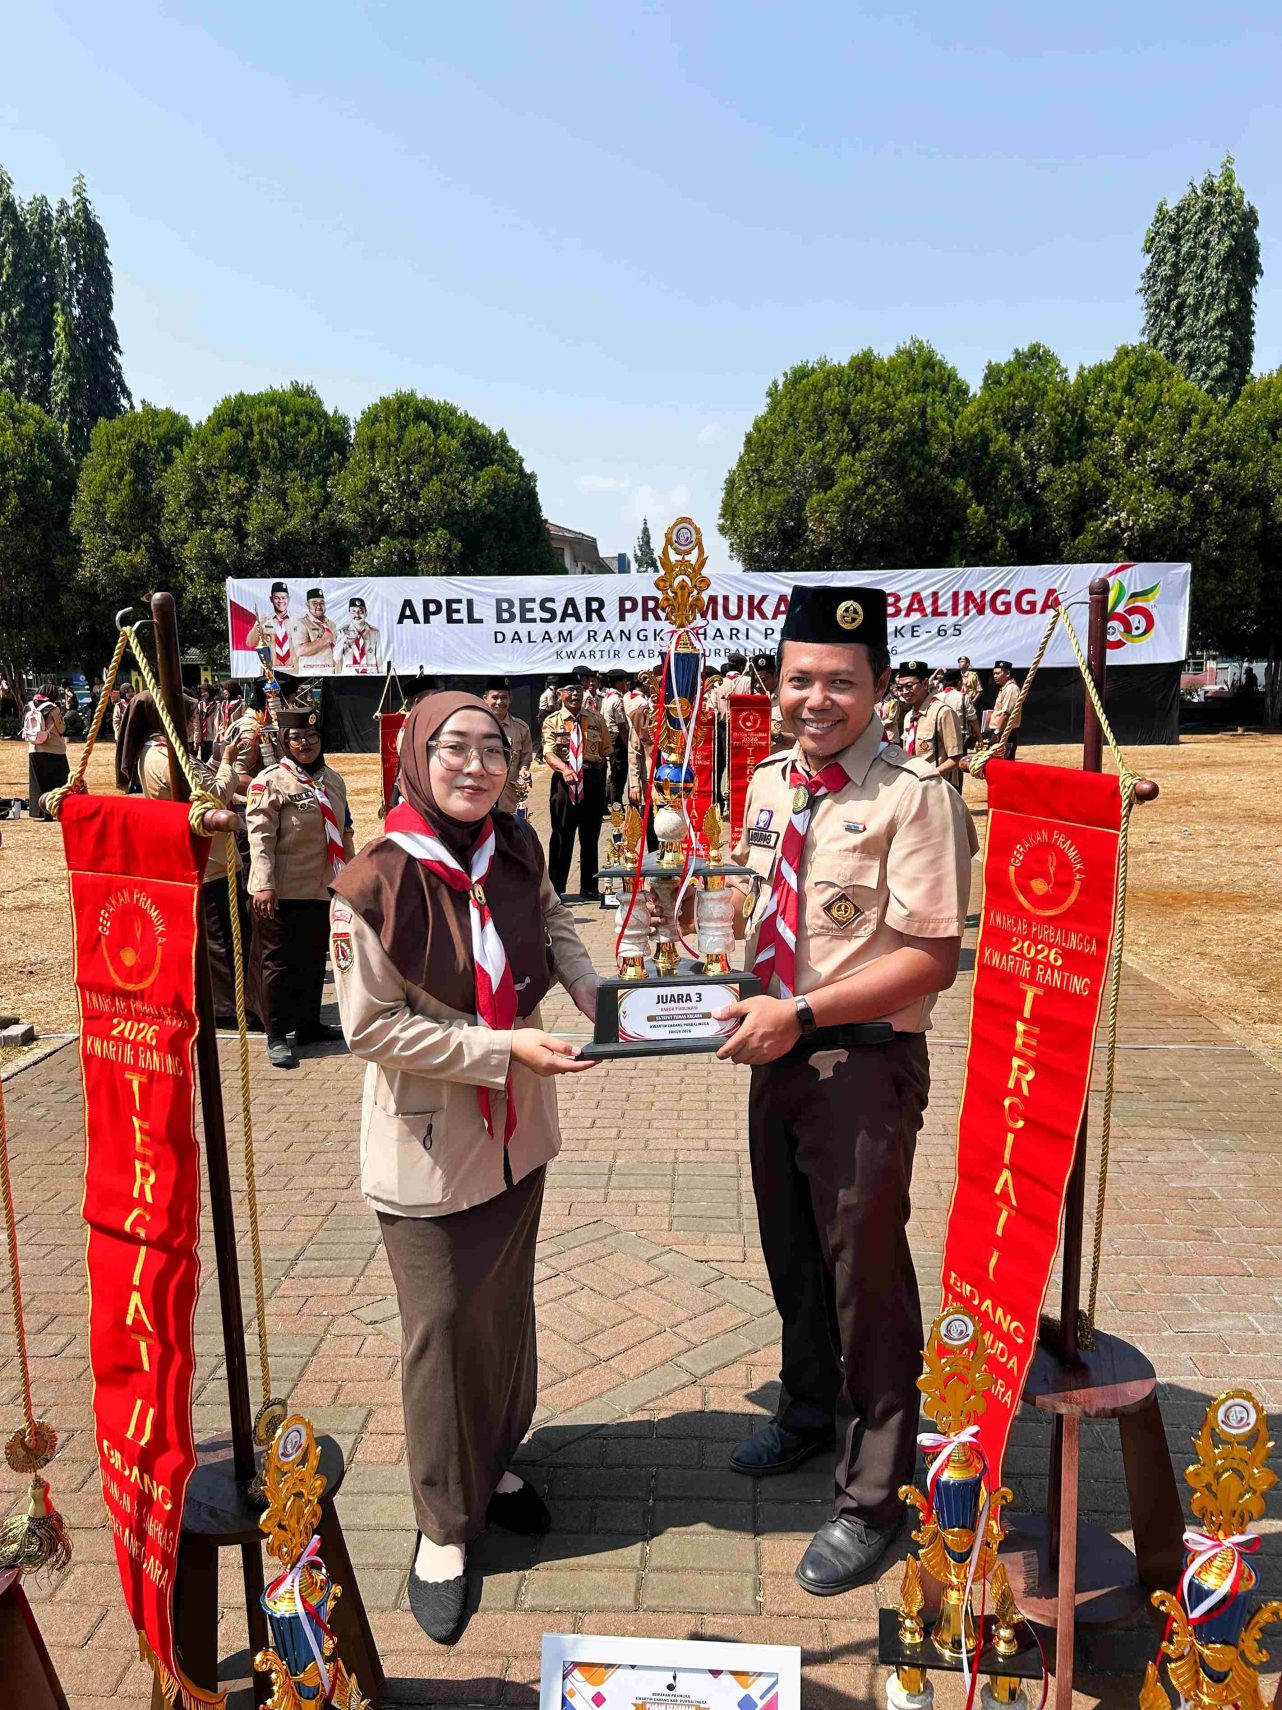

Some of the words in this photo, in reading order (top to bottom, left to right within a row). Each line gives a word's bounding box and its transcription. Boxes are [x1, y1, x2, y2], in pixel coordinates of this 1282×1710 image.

[397, 597, 484, 625] APEL
[495, 596, 607, 624] BESAR
[618, 594, 790, 622] PRMUKA
[886, 588, 1060, 619] BALINGGA
[493, 629, 577, 644] DALAM
[894, 623, 963, 637] KE-65
[556, 649, 621, 660] KWARTIR
[1010, 828, 1048, 866] GERAKAN
[1052, 830, 1086, 880] PRAMUKA
[98, 888, 130, 935] GERAKAN
[133, 888, 167, 944] PRAMUKA
[989, 910, 1028, 936] KWARCAB
[1031, 921, 1097, 956] PURBALINGGA
[983, 946, 1031, 979] KWARTIR
[1036, 964, 1091, 996] RANTING
[1009, 936, 1063, 966] 2026
[656, 993, 692, 1004] JUARA
[695, 992, 702, 1002] 3
[110, 1017, 160, 1046] 2026
[86, 1034, 134, 1065] KWARTIR
[138, 1046, 184, 1077] RANTING
[950, 1271, 1025, 1344] BIDANG
